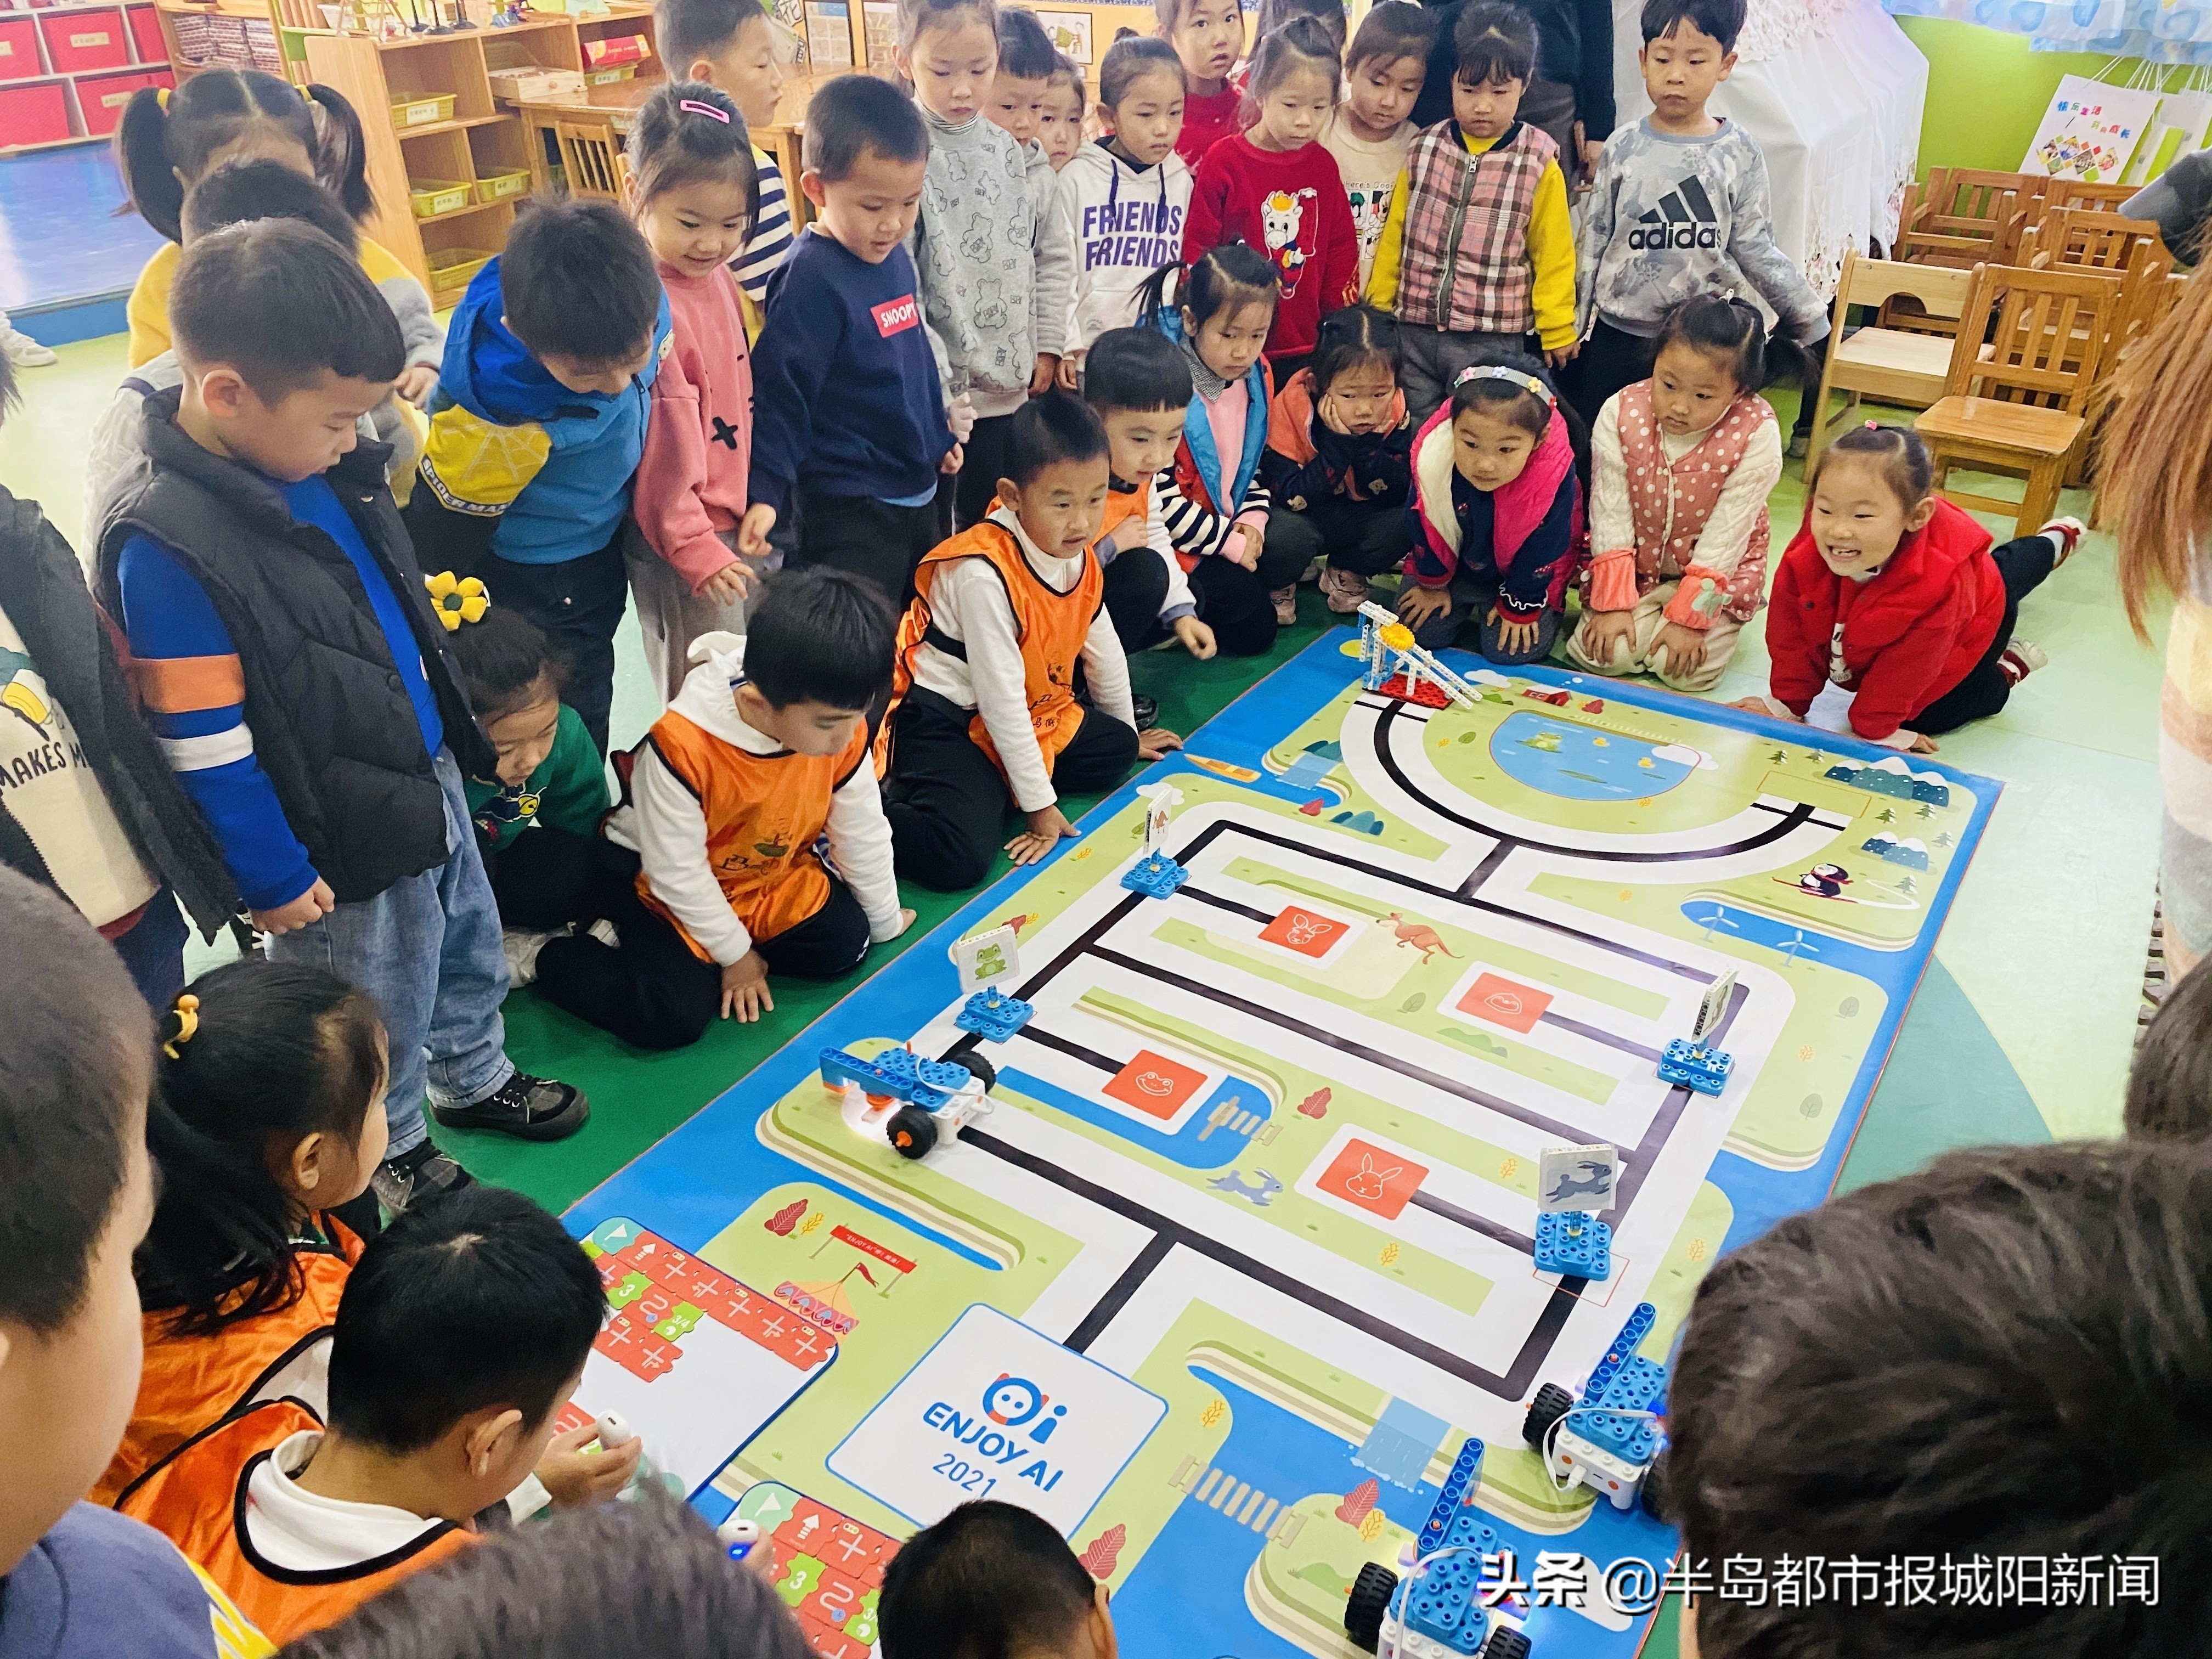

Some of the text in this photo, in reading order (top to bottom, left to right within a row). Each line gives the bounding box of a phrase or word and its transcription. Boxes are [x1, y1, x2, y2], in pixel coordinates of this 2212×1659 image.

[1083, 201, 1182, 238] FRIENDS
[1628, 222, 1722, 250] adidas
[1086, 236, 1178, 271] FRIENDS
[881, 302, 917, 329] SNOOPY
[923, 1402, 1064, 1492] ENJOY AI
[933, 1453, 997, 1498] 2021
